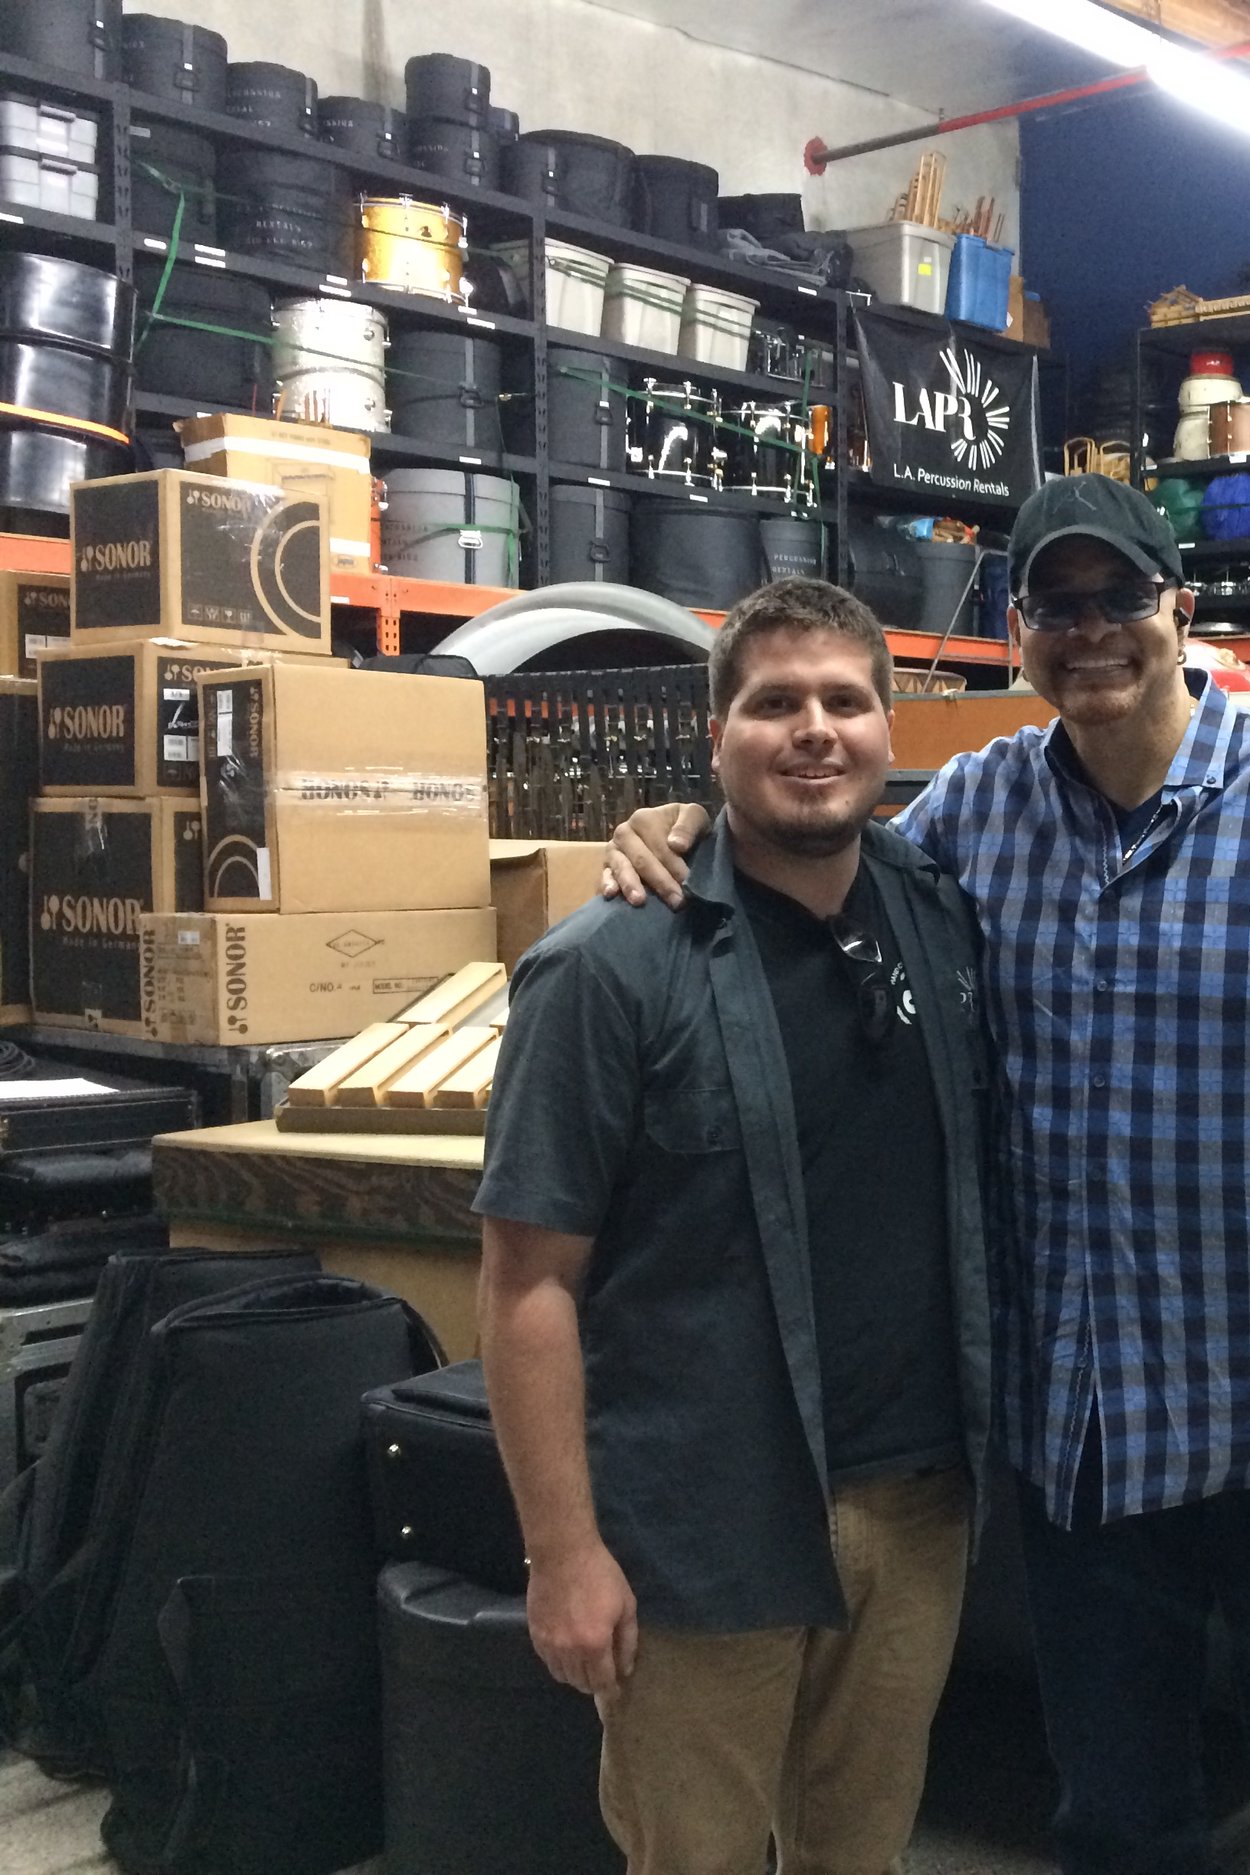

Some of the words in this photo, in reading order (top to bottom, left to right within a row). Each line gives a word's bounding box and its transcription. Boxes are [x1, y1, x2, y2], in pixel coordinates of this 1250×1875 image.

[893, 381, 976, 440] LAPR
[894, 463, 915, 480] L.A.
[917, 467, 971, 491] Percussion
[973, 478, 1010, 497] Rentals
[95, 541, 151, 570] SONOR
[39, 592, 70, 607] SON
[64, 704, 124, 739] SONOR
[62, 895, 140, 934] SONOR
[103, 939, 140, 950] German
[143, 929, 155, 1013] SONOR
[226, 927, 247, 1010] SONOR
